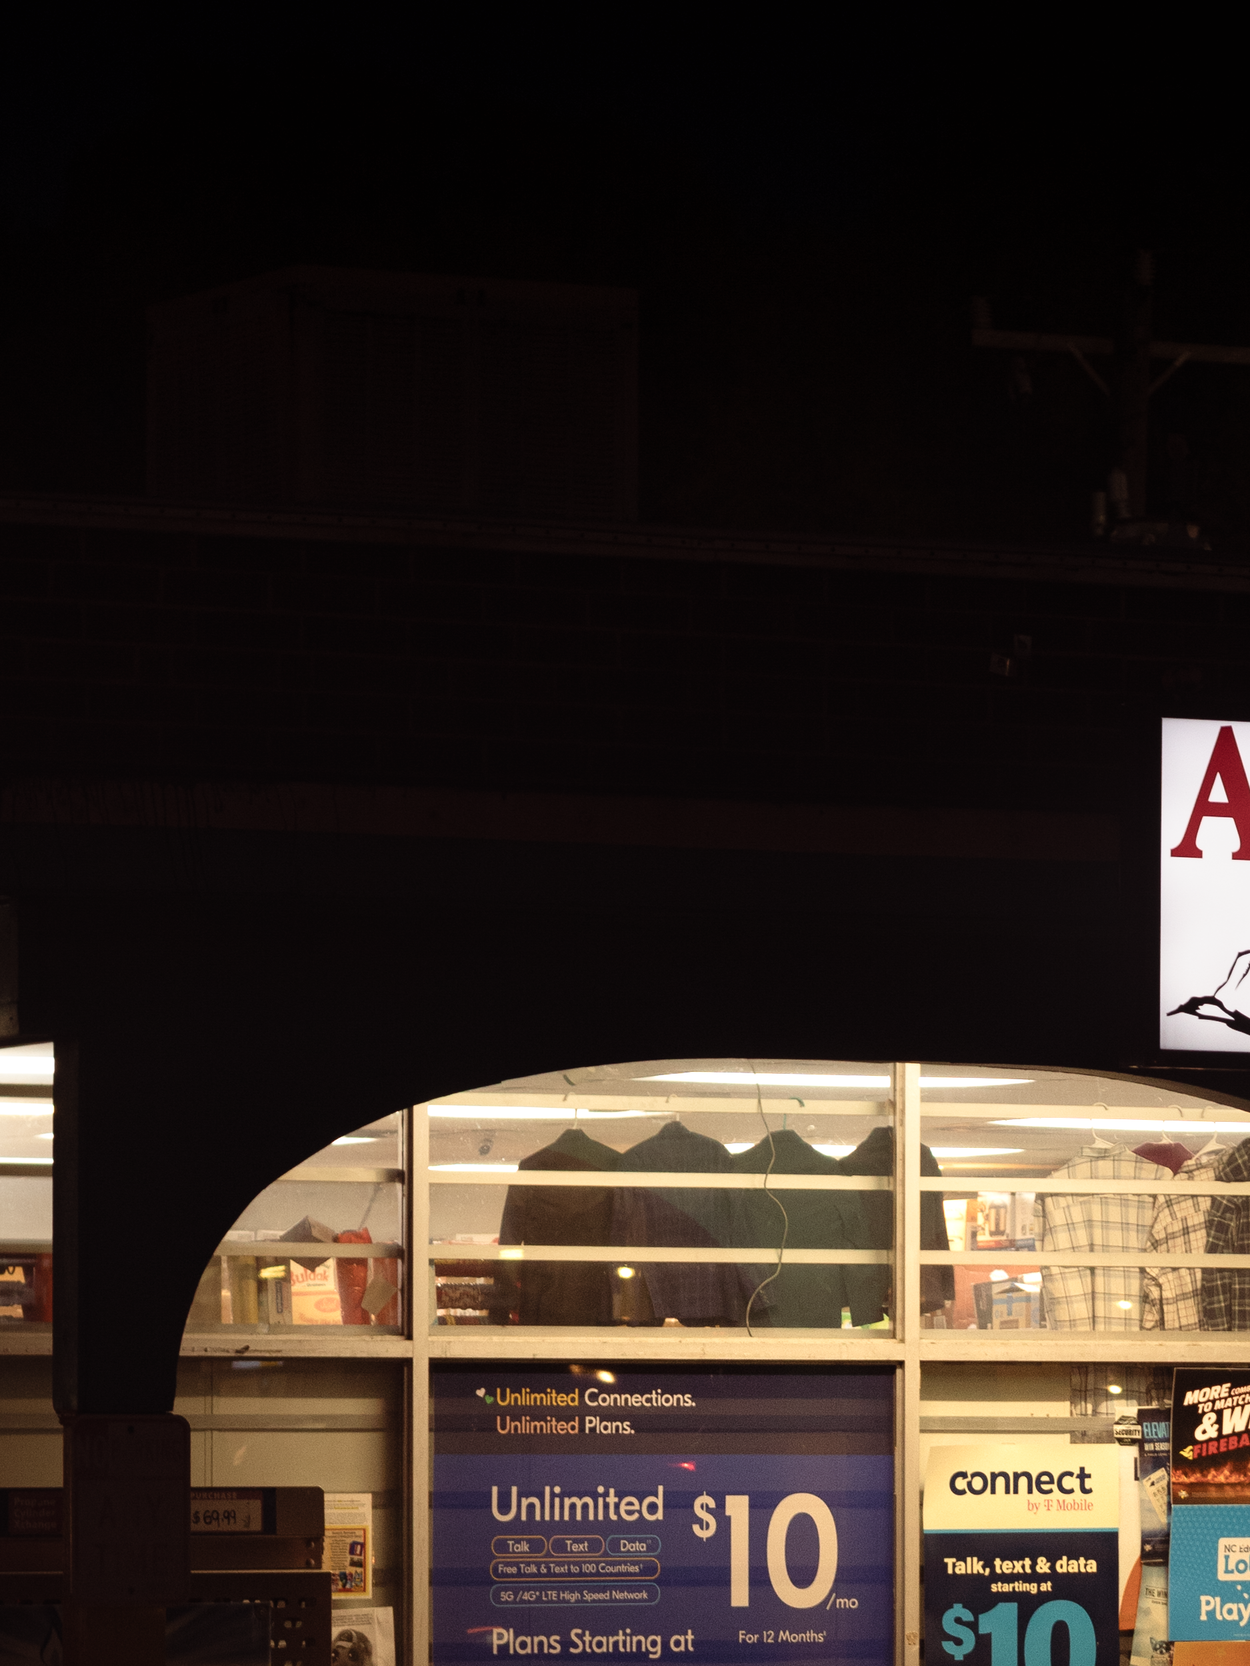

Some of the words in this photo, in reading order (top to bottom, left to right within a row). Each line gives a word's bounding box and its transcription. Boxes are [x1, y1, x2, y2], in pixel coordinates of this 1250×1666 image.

[496, 1388, 579, 1408] Unlimited
[584, 1388, 696, 1408] Connections.
[1183, 1382, 1232, 1406] MORE
[1197, 1402, 1213, 1414] TO
[496, 1415, 579, 1435] Unlimited
[585, 1415, 635, 1435] Plans.
[1194, 1411, 1220, 1442] &
[949, 1466, 1093, 1495] connect
[1027, 1499, 1040, 1514] by
[1056, 1499, 1094, 1512] Mobile
[490, 1485, 664, 1522] Unlimited
[692, 1491, 838, 1609] $10
[507, 1540, 530, 1552] Talk
[565, 1540, 588, 1552] Text
[1224, 1545, 1237, 1553] NC
[498, 1564, 517, 1574] Free
[520, 1563, 538, 1574] Talk
[540, 1564, 547, 1573] &
[549, 1563, 568, 1574] Text
[570, 1564, 579, 1573] to
[581, 1563, 596, 1573] 100
[943, 1557, 990, 1576] Talk,
[994, 1557, 1032, 1574] text
[1035, 1557, 1051, 1573] &
[1056, 1556, 1097, 1573] data
[990, 1581, 1038, 1595] starting
[1040, 1581, 1052, 1592] at
[500, 1591, 514, 1602] 5G
[542, 1590, 558, 1600] LTE
[560, 1590, 581, 1603] High
[582, 1590, 610, 1603] Speed
[611, 1590, 649, 1600] Network
[491, 1628, 561, 1655] Plans
[569, 1628, 661, 1659] Starting
[669, 1629, 695, 1652] at
[738, 1631, 759, 1643] For
[762, 1631, 774, 1643] 12
